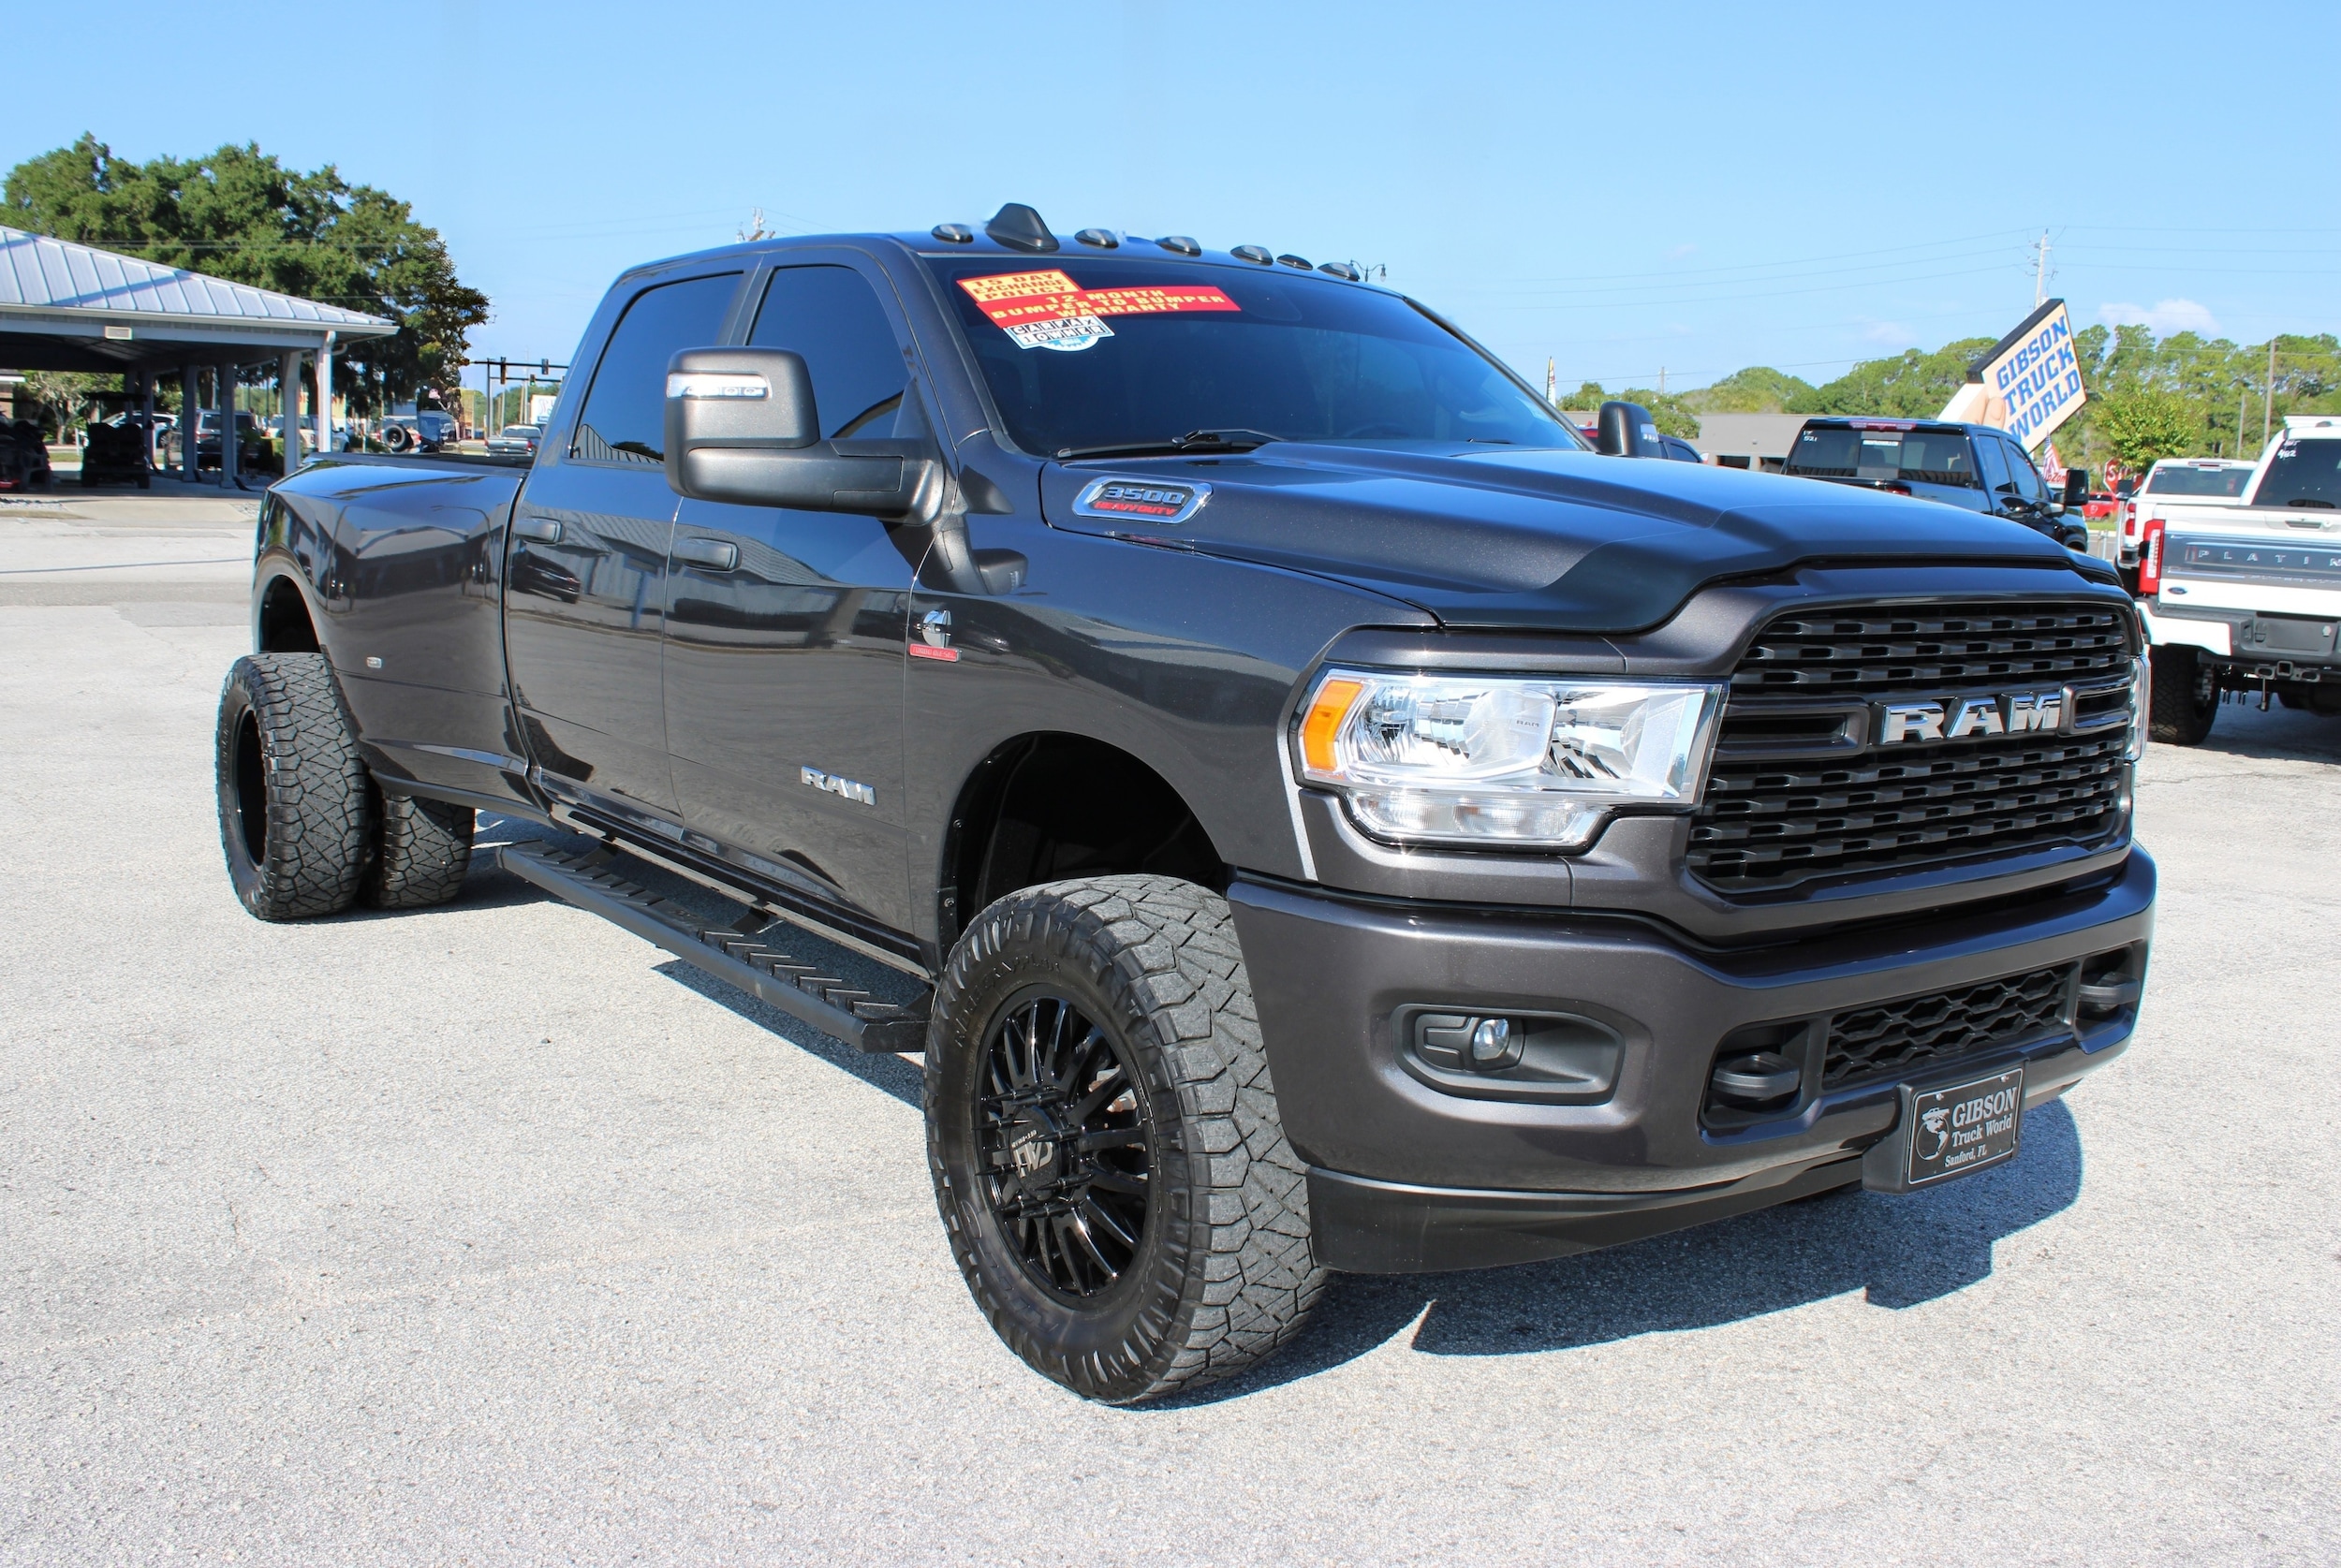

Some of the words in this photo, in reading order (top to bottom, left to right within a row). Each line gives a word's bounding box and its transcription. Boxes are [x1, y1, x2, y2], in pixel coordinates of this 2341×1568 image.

[973, 279, 1067, 294] EXCHANGE
[1011, 273, 1053, 283] DAY
[984, 286, 1066, 300] POLICY
[1046, 295, 1078, 303] 12
[1086, 290, 1166, 300] MONTH
[991, 300, 1092, 318] BUMPER
[1135, 296, 1226, 305] BUMPER
[1055, 302, 1181, 317] WARRANTY
[1012, 317, 1097, 334] CARFAX
[1034, 327, 1106, 343] OWNER
[1995, 315, 2069, 390] GIBSON
[2003, 341, 2074, 416] TRUCK
[2009, 369, 2081, 444] WORLD
[1104, 486, 1185, 505] 3500
[1094, 501, 1138, 512] HEAVY
[1137, 505, 1178, 516] DUTY
[1874, 691, 2061, 745] RAM
[801, 765, 876, 806] RAM
[1952, 1087, 2017, 1127] GIBSON
[1951, 1124, 1983, 1148] Truck
[1985, 1113, 2012, 1137] World
[1945, 1149, 1976, 1167] Sanford,
[1977, 1144, 1987, 1157] FL
